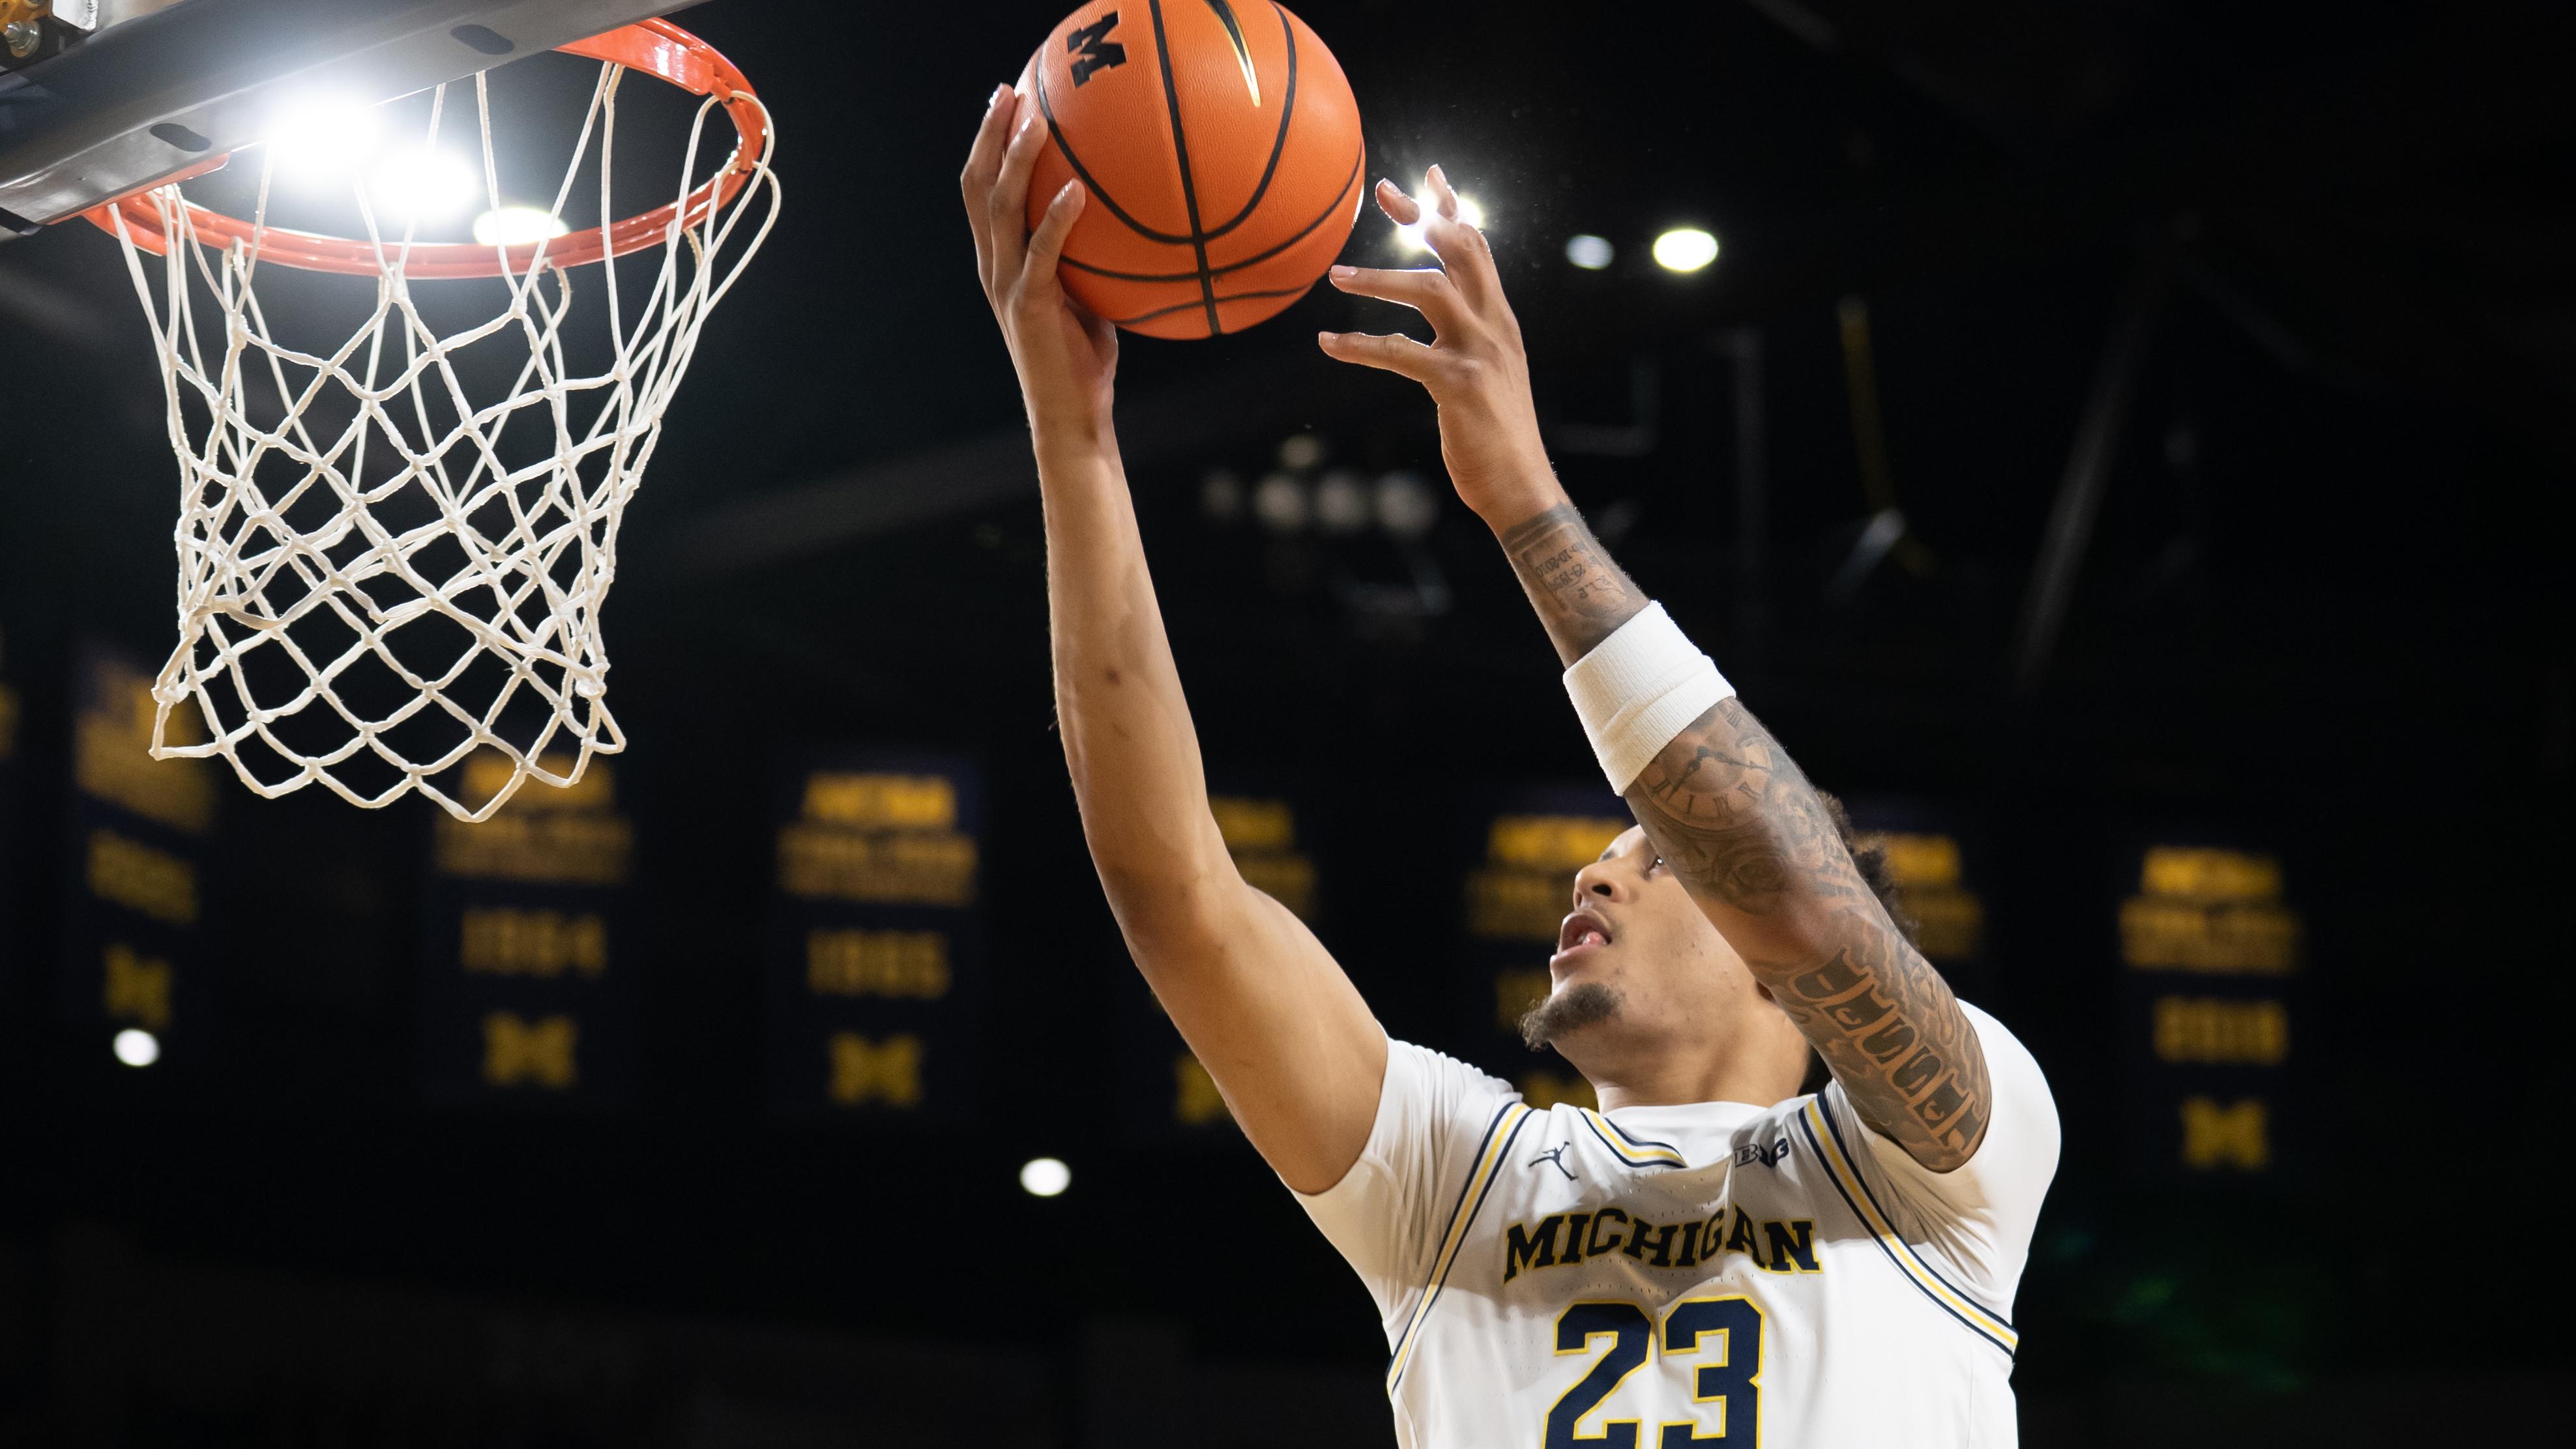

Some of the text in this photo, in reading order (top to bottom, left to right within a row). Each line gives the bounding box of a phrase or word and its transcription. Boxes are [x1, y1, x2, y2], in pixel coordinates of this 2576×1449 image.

[1068, 11, 1126, 88] M
[1503, 1203, 1824, 1285] MICHIGAN
[1542, 1293, 1766, 1449] 23
